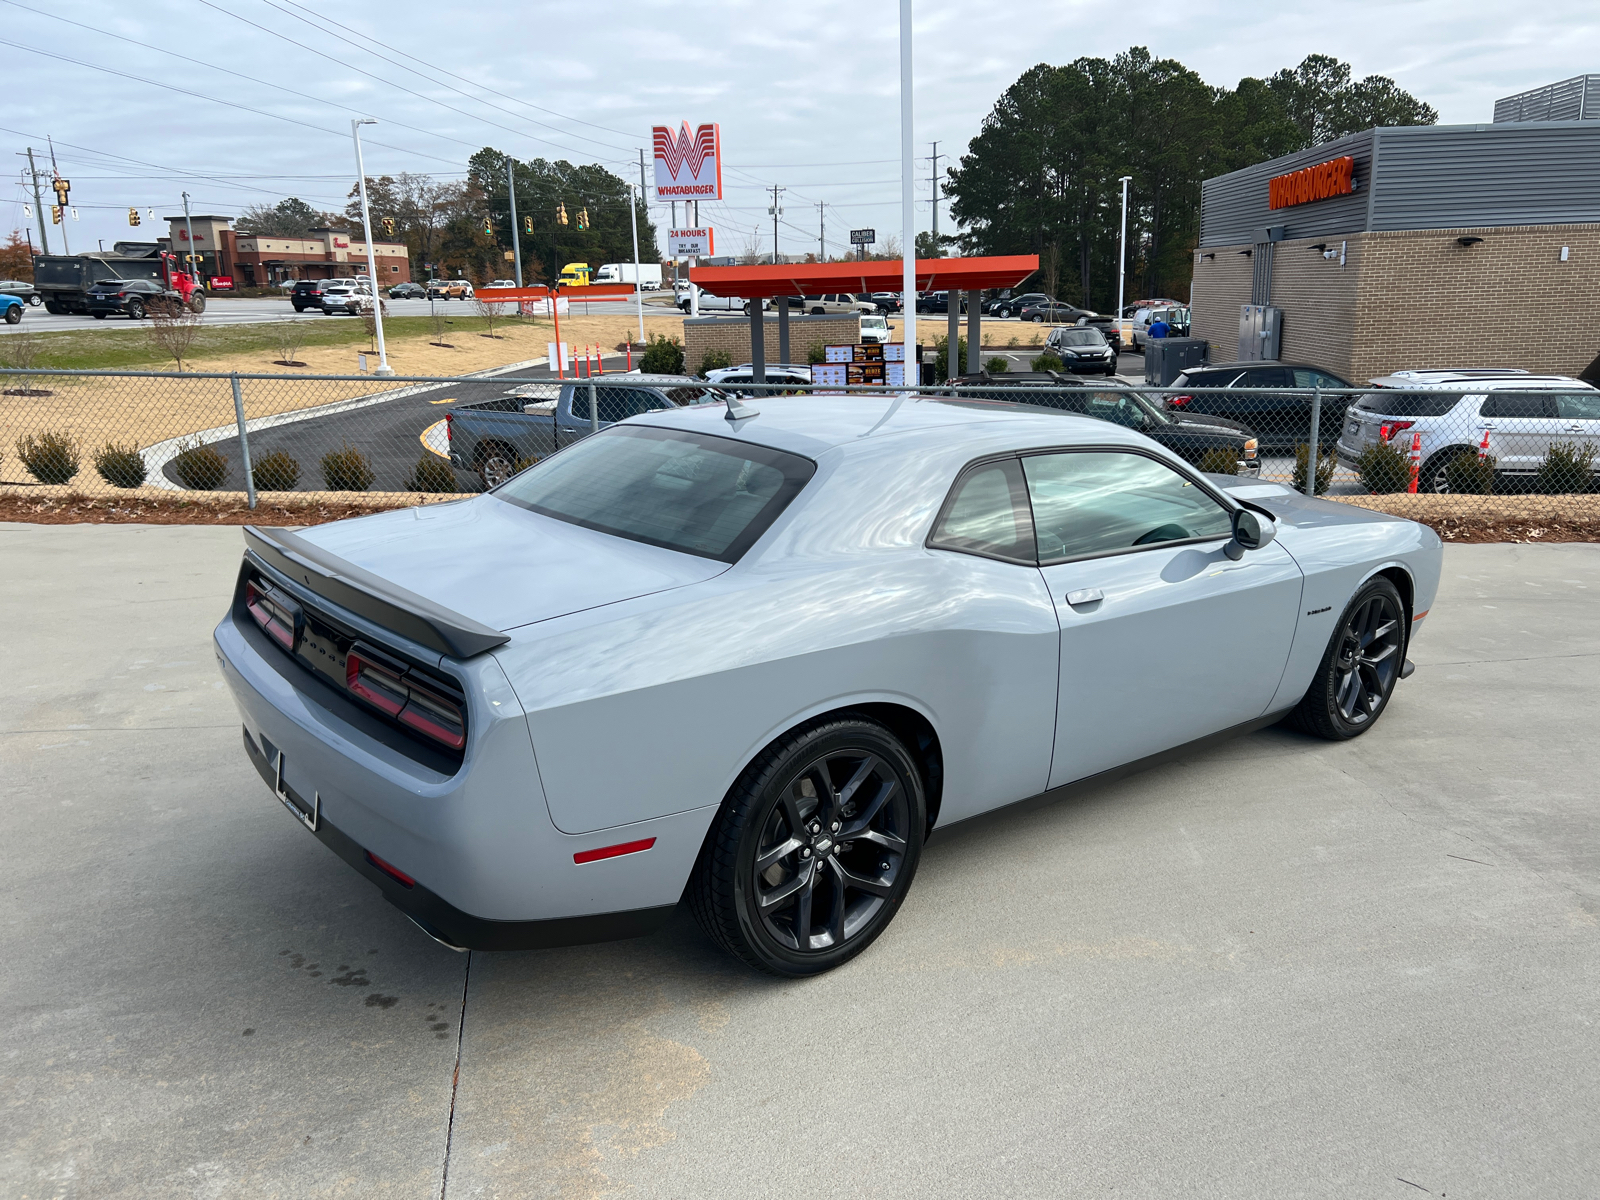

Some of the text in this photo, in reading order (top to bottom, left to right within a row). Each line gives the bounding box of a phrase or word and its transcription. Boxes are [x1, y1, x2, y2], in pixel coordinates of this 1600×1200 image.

[1269, 156, 1352, 210] WHATABURGER
[658, 184, 714, 196] WHATABURGER
[670, 229, 707, 238] 24 HOURS
